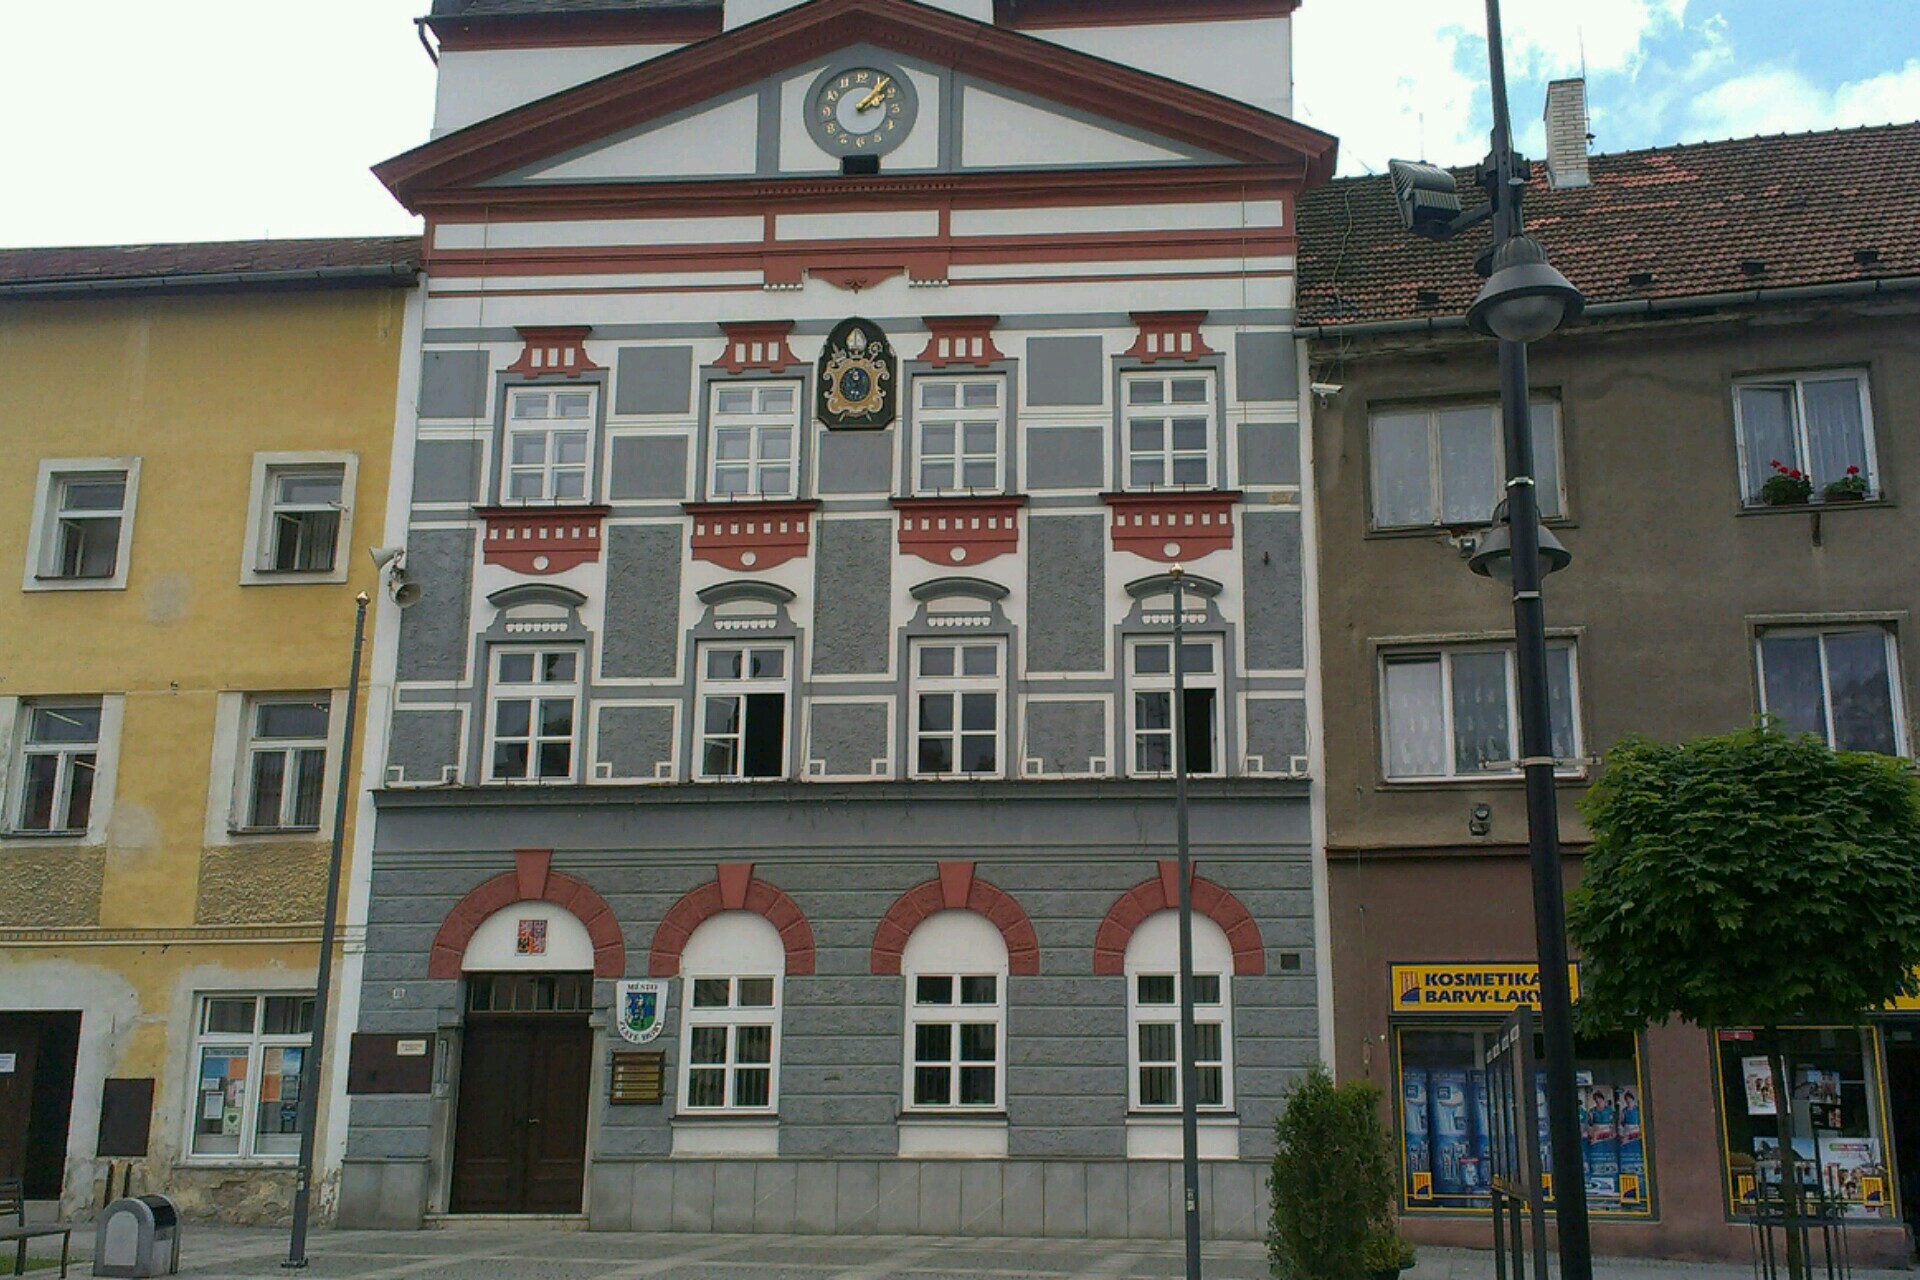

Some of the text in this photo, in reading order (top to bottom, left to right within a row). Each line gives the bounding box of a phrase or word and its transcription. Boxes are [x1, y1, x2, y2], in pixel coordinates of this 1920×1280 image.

[840, 78, 849, 88] 11
[856, 72, 868, 83] 12
[827, 90, 839, 101] 10
[887, 87, 896, 98] 2
[822, 106, 831, 117] 9
[892, 103, 900, 113] 3
[826, 122, 836, 134] 8
[886, 120, 894, 130] 4
[855, 136, 865, 148] 6
[873, 133, 882, 143] 5
[1425, 972, 1541, 986] KOSMETIKA
[627, 982, 658, 990] MĚSTO
